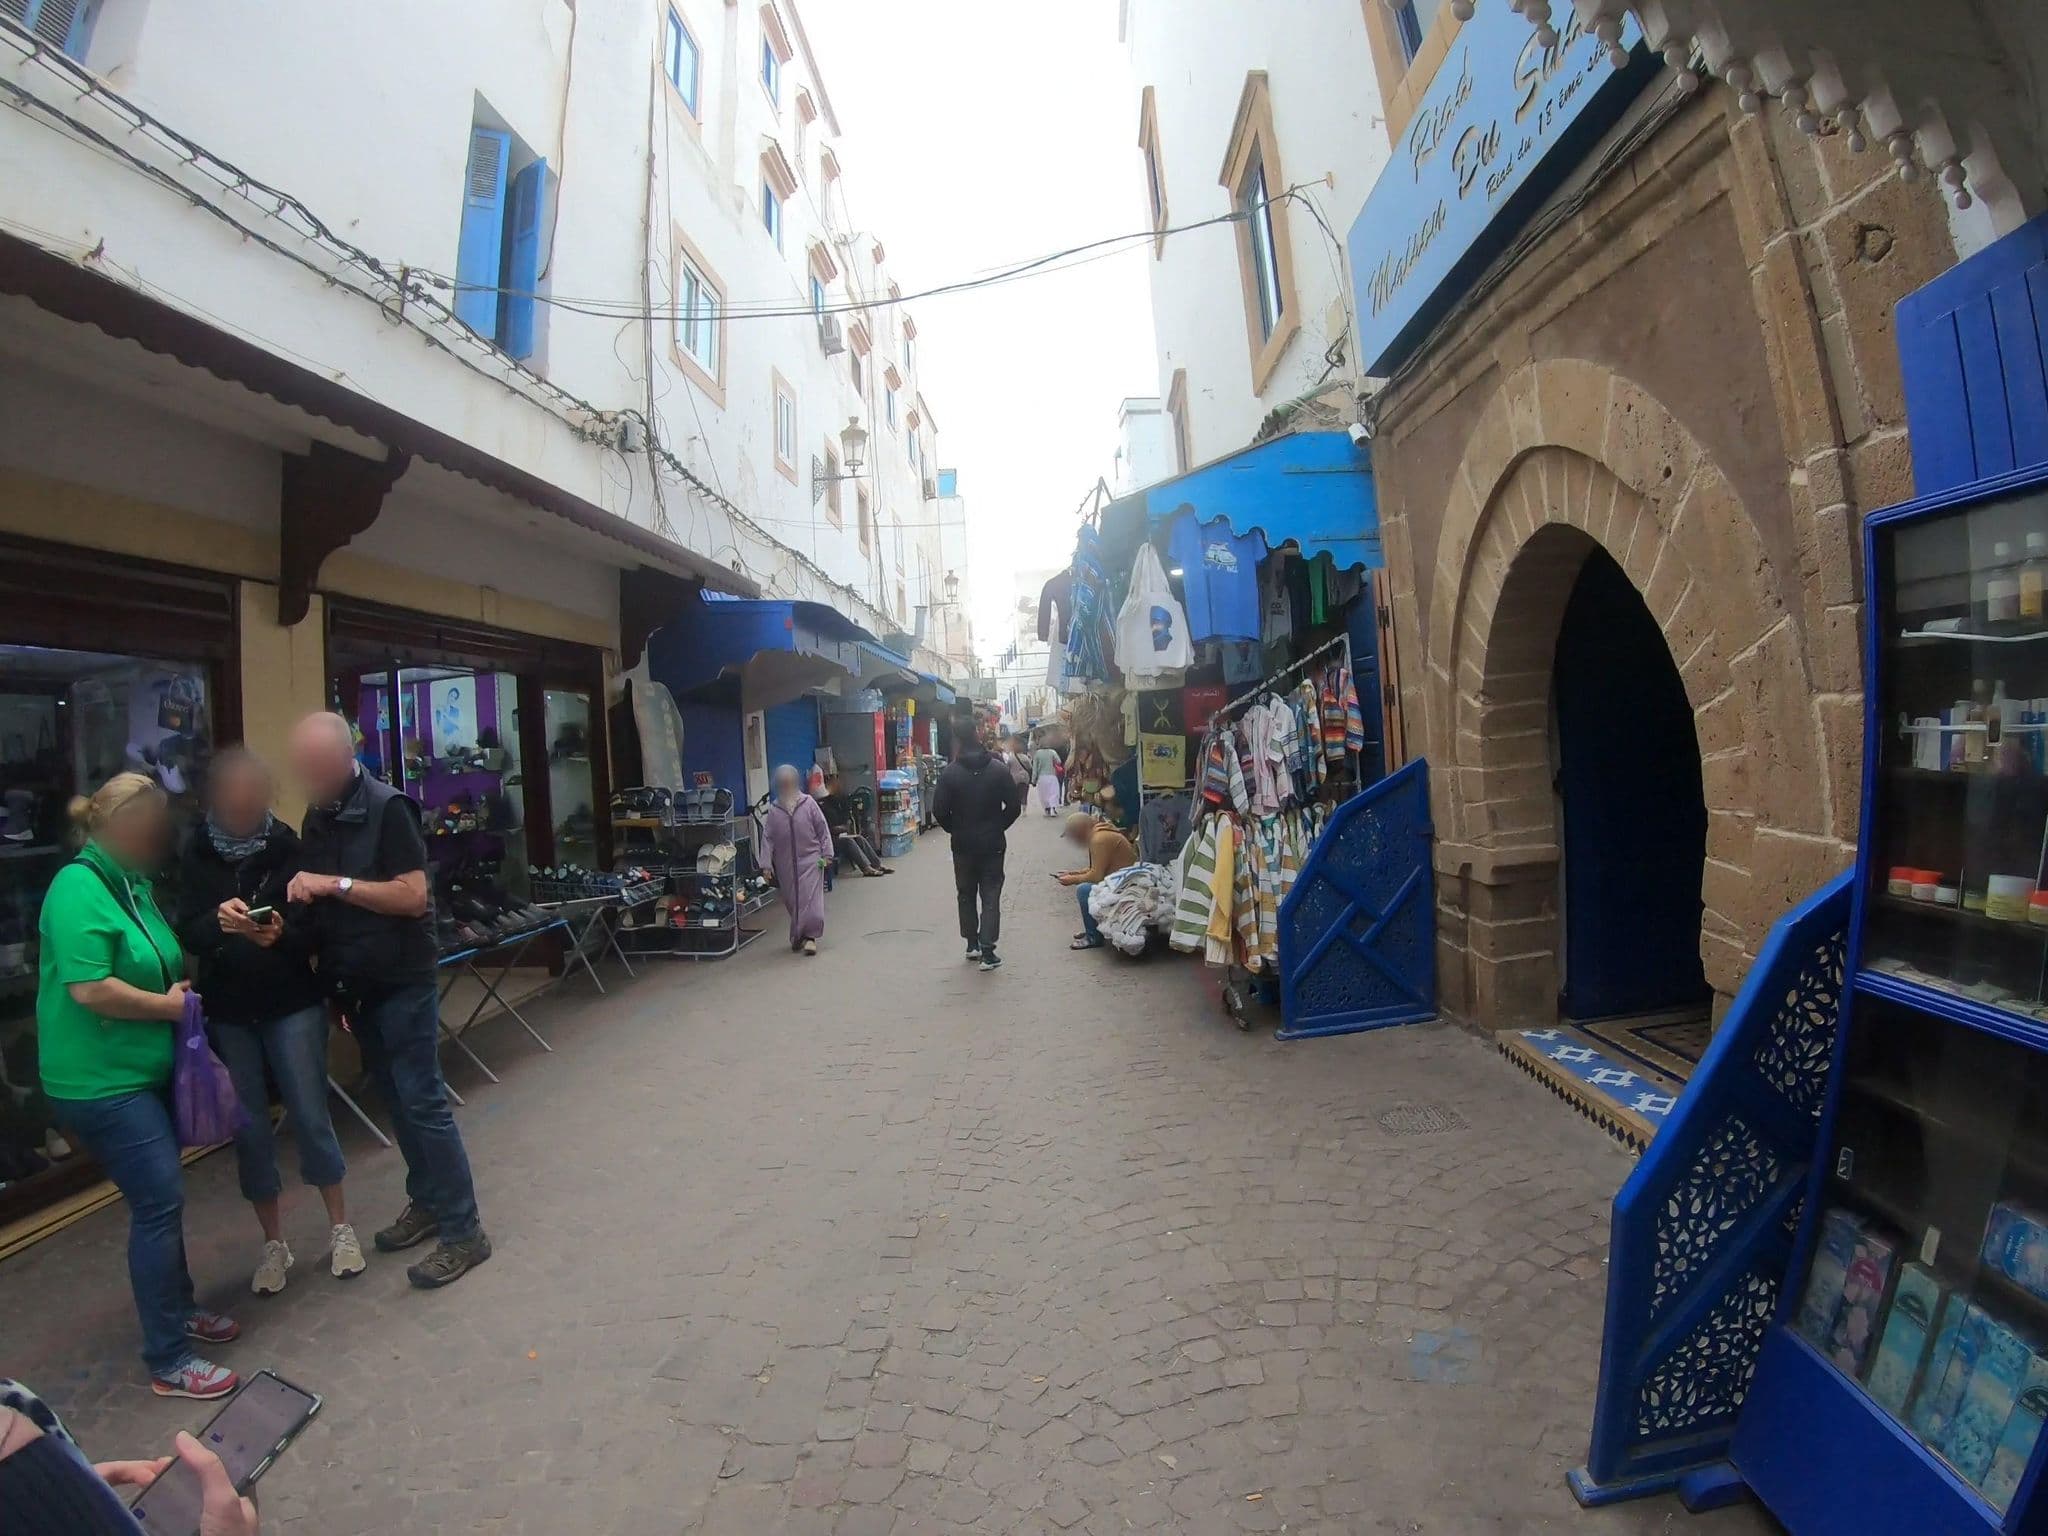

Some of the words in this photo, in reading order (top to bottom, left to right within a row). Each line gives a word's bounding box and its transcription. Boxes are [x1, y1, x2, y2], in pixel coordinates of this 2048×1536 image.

[1410, 46, 1473, 184] Riad
[1485, 152, 1514, 202] Riad
[1517, 136, 1533, 161] du
[1538, 98, 1553, 135] 18
[1368, 197, 1447, 318] Maison
[1452, 119, 1501, 201] Du
